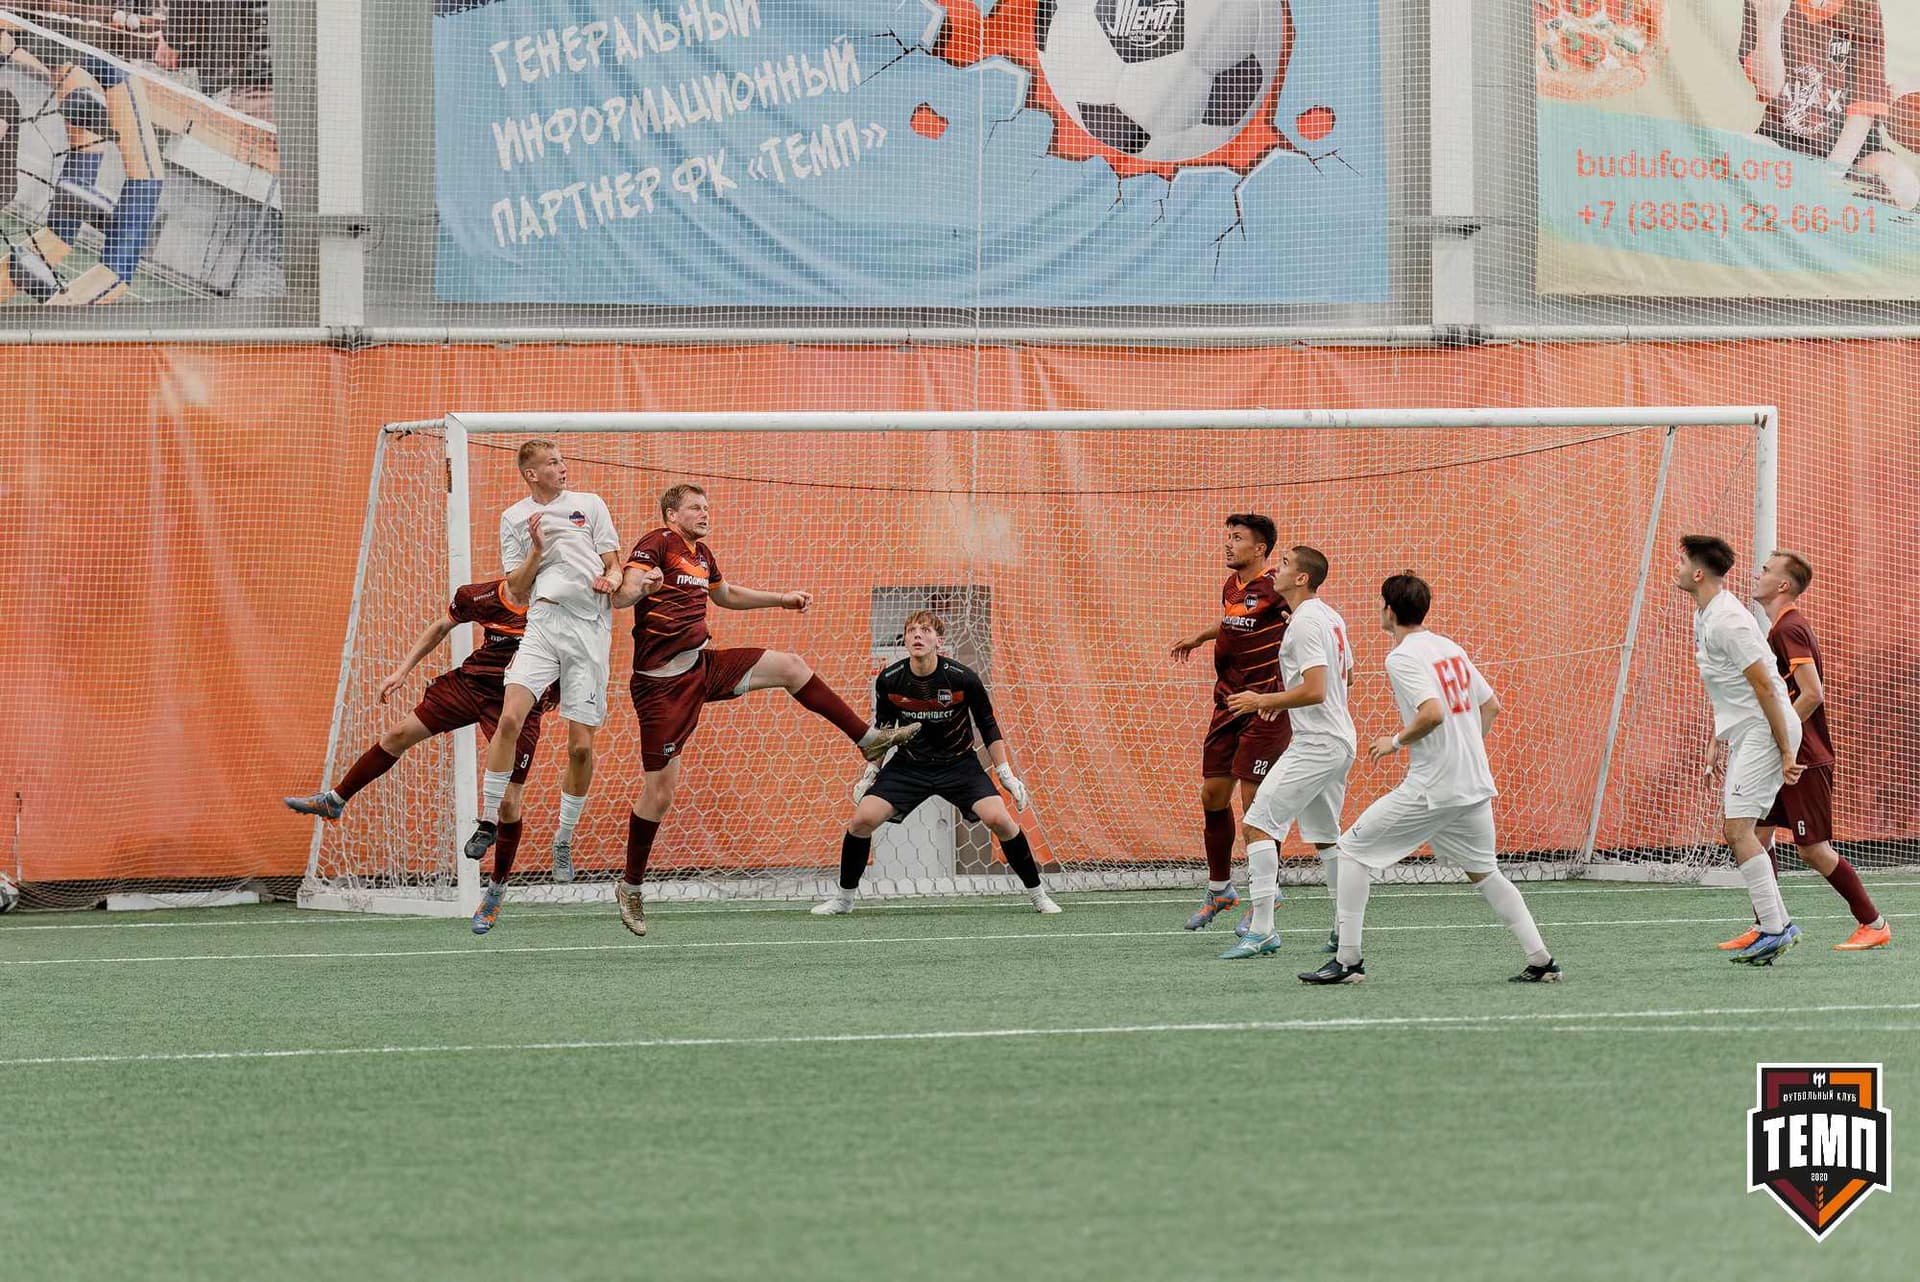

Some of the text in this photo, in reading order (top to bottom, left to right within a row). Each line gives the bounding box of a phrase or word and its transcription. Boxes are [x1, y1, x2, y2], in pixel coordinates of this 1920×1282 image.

[491, 34, 861, 171] ИНФОРМАЦИОННЫЙ
[491, 118, 888, 247] ПАРТНЕР ФК «ТЕМП»
[1576, 150, 1793, 189] budufood.org
[1577, 200, 1876, 238] +7 (3852) 22-66-01
[1433, 656, 1472, 713] 69
[520, 753, 530, 769] 3
[1252, 759, 1269, 776] 22
[1797, 820, 1806, 836] 6
